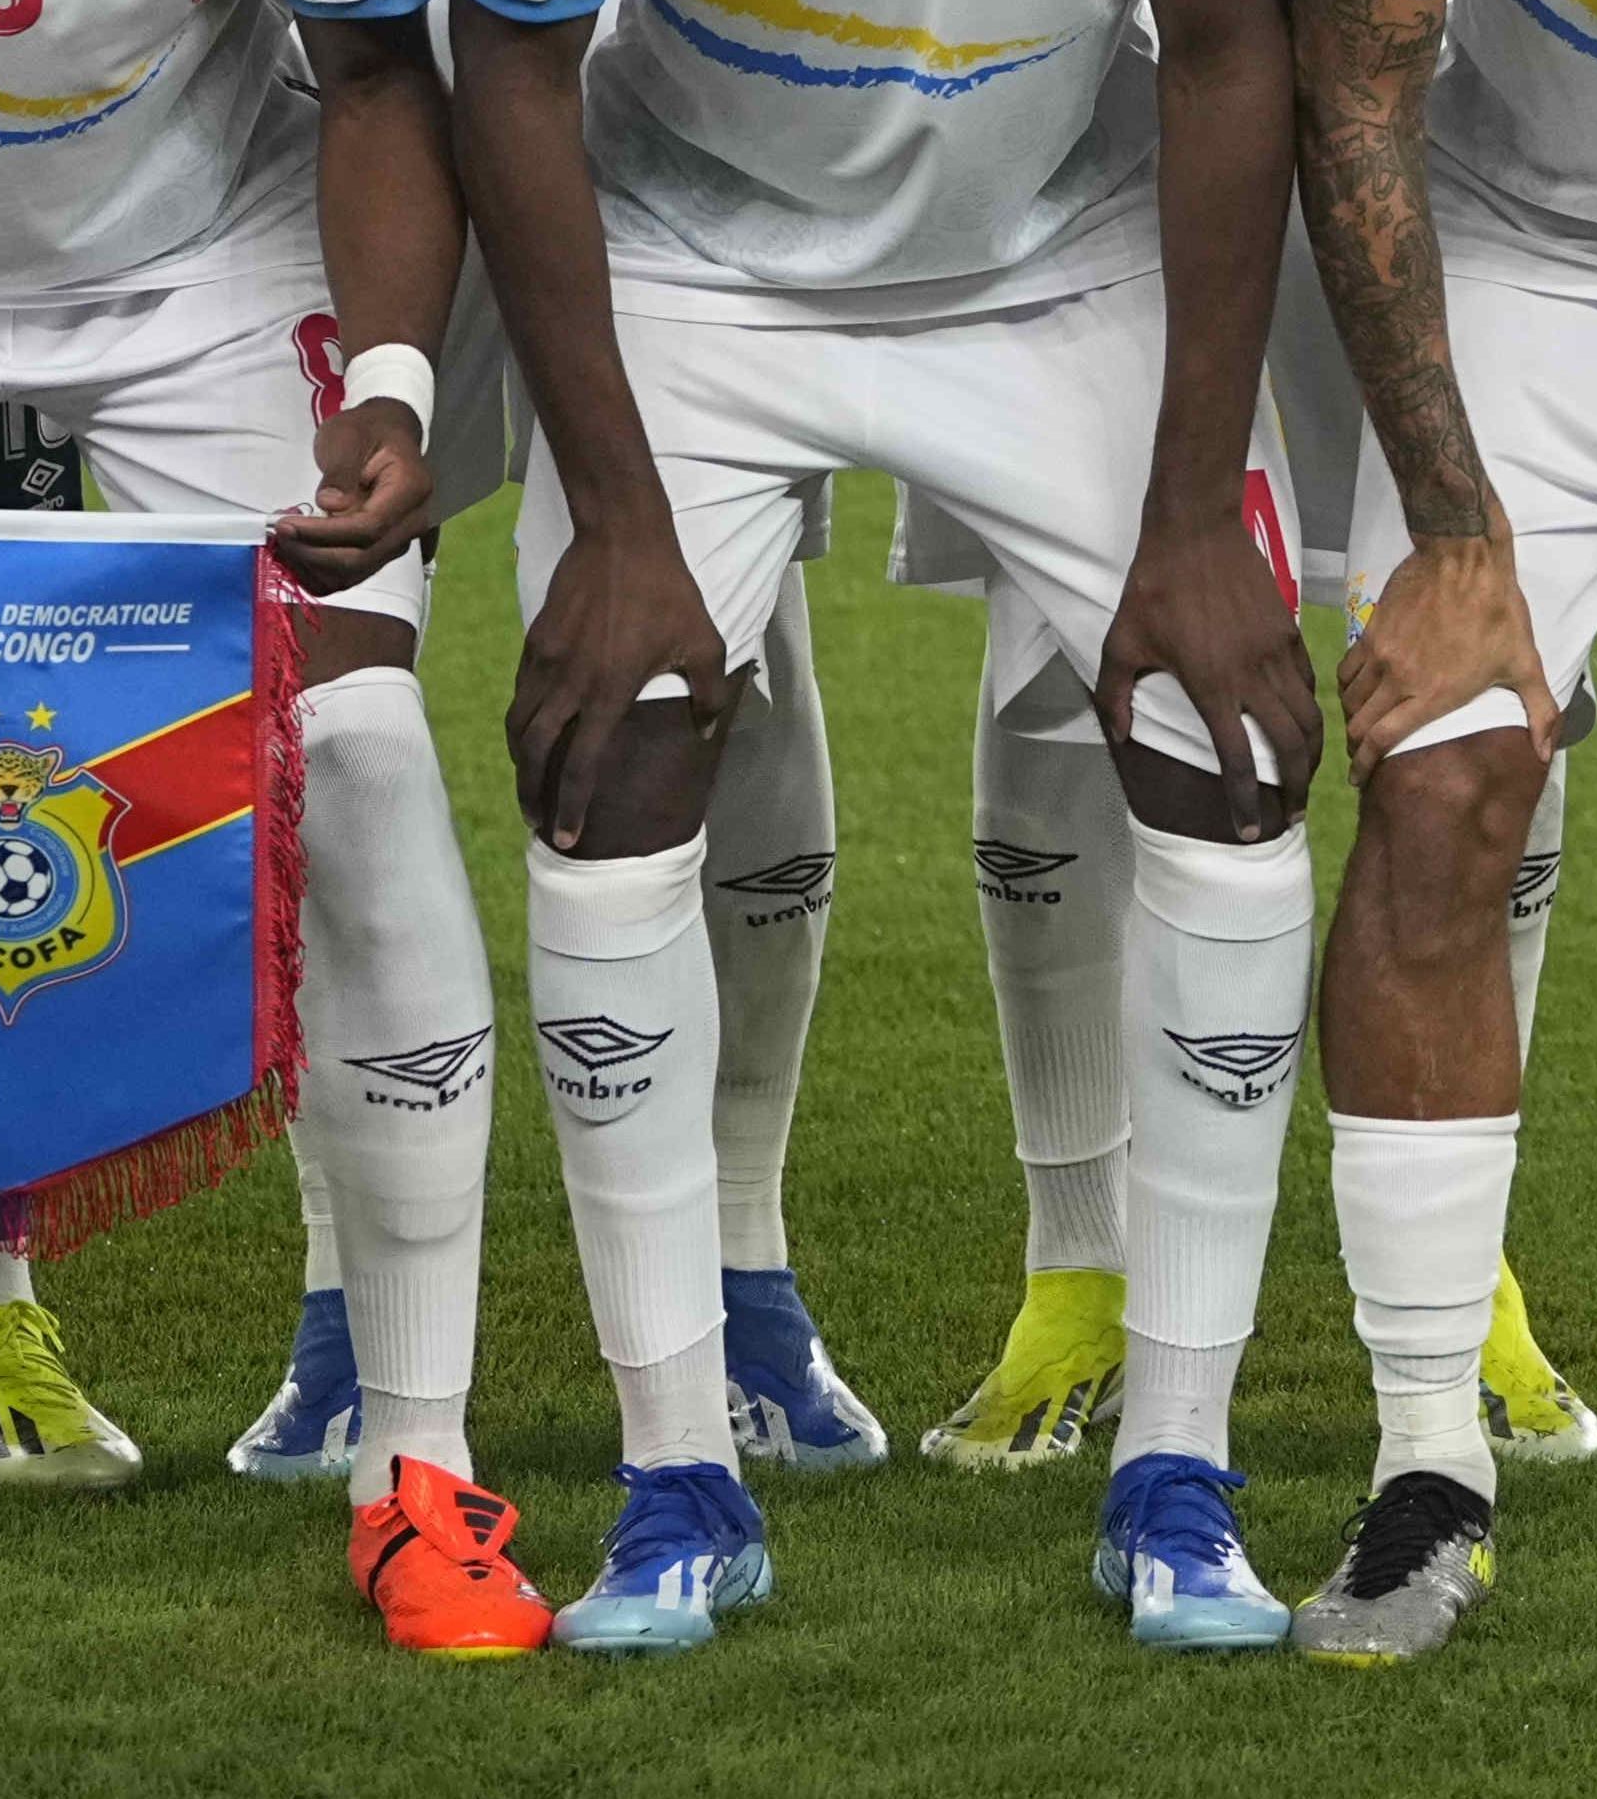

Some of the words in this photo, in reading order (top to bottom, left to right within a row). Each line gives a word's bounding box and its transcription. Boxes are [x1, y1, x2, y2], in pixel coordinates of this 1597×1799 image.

[0, 603, 193, 627] DEMOCRATIQUE
[976, 880, 1062, 906] mbro
[363, 1064, 482, 1113] umbro
